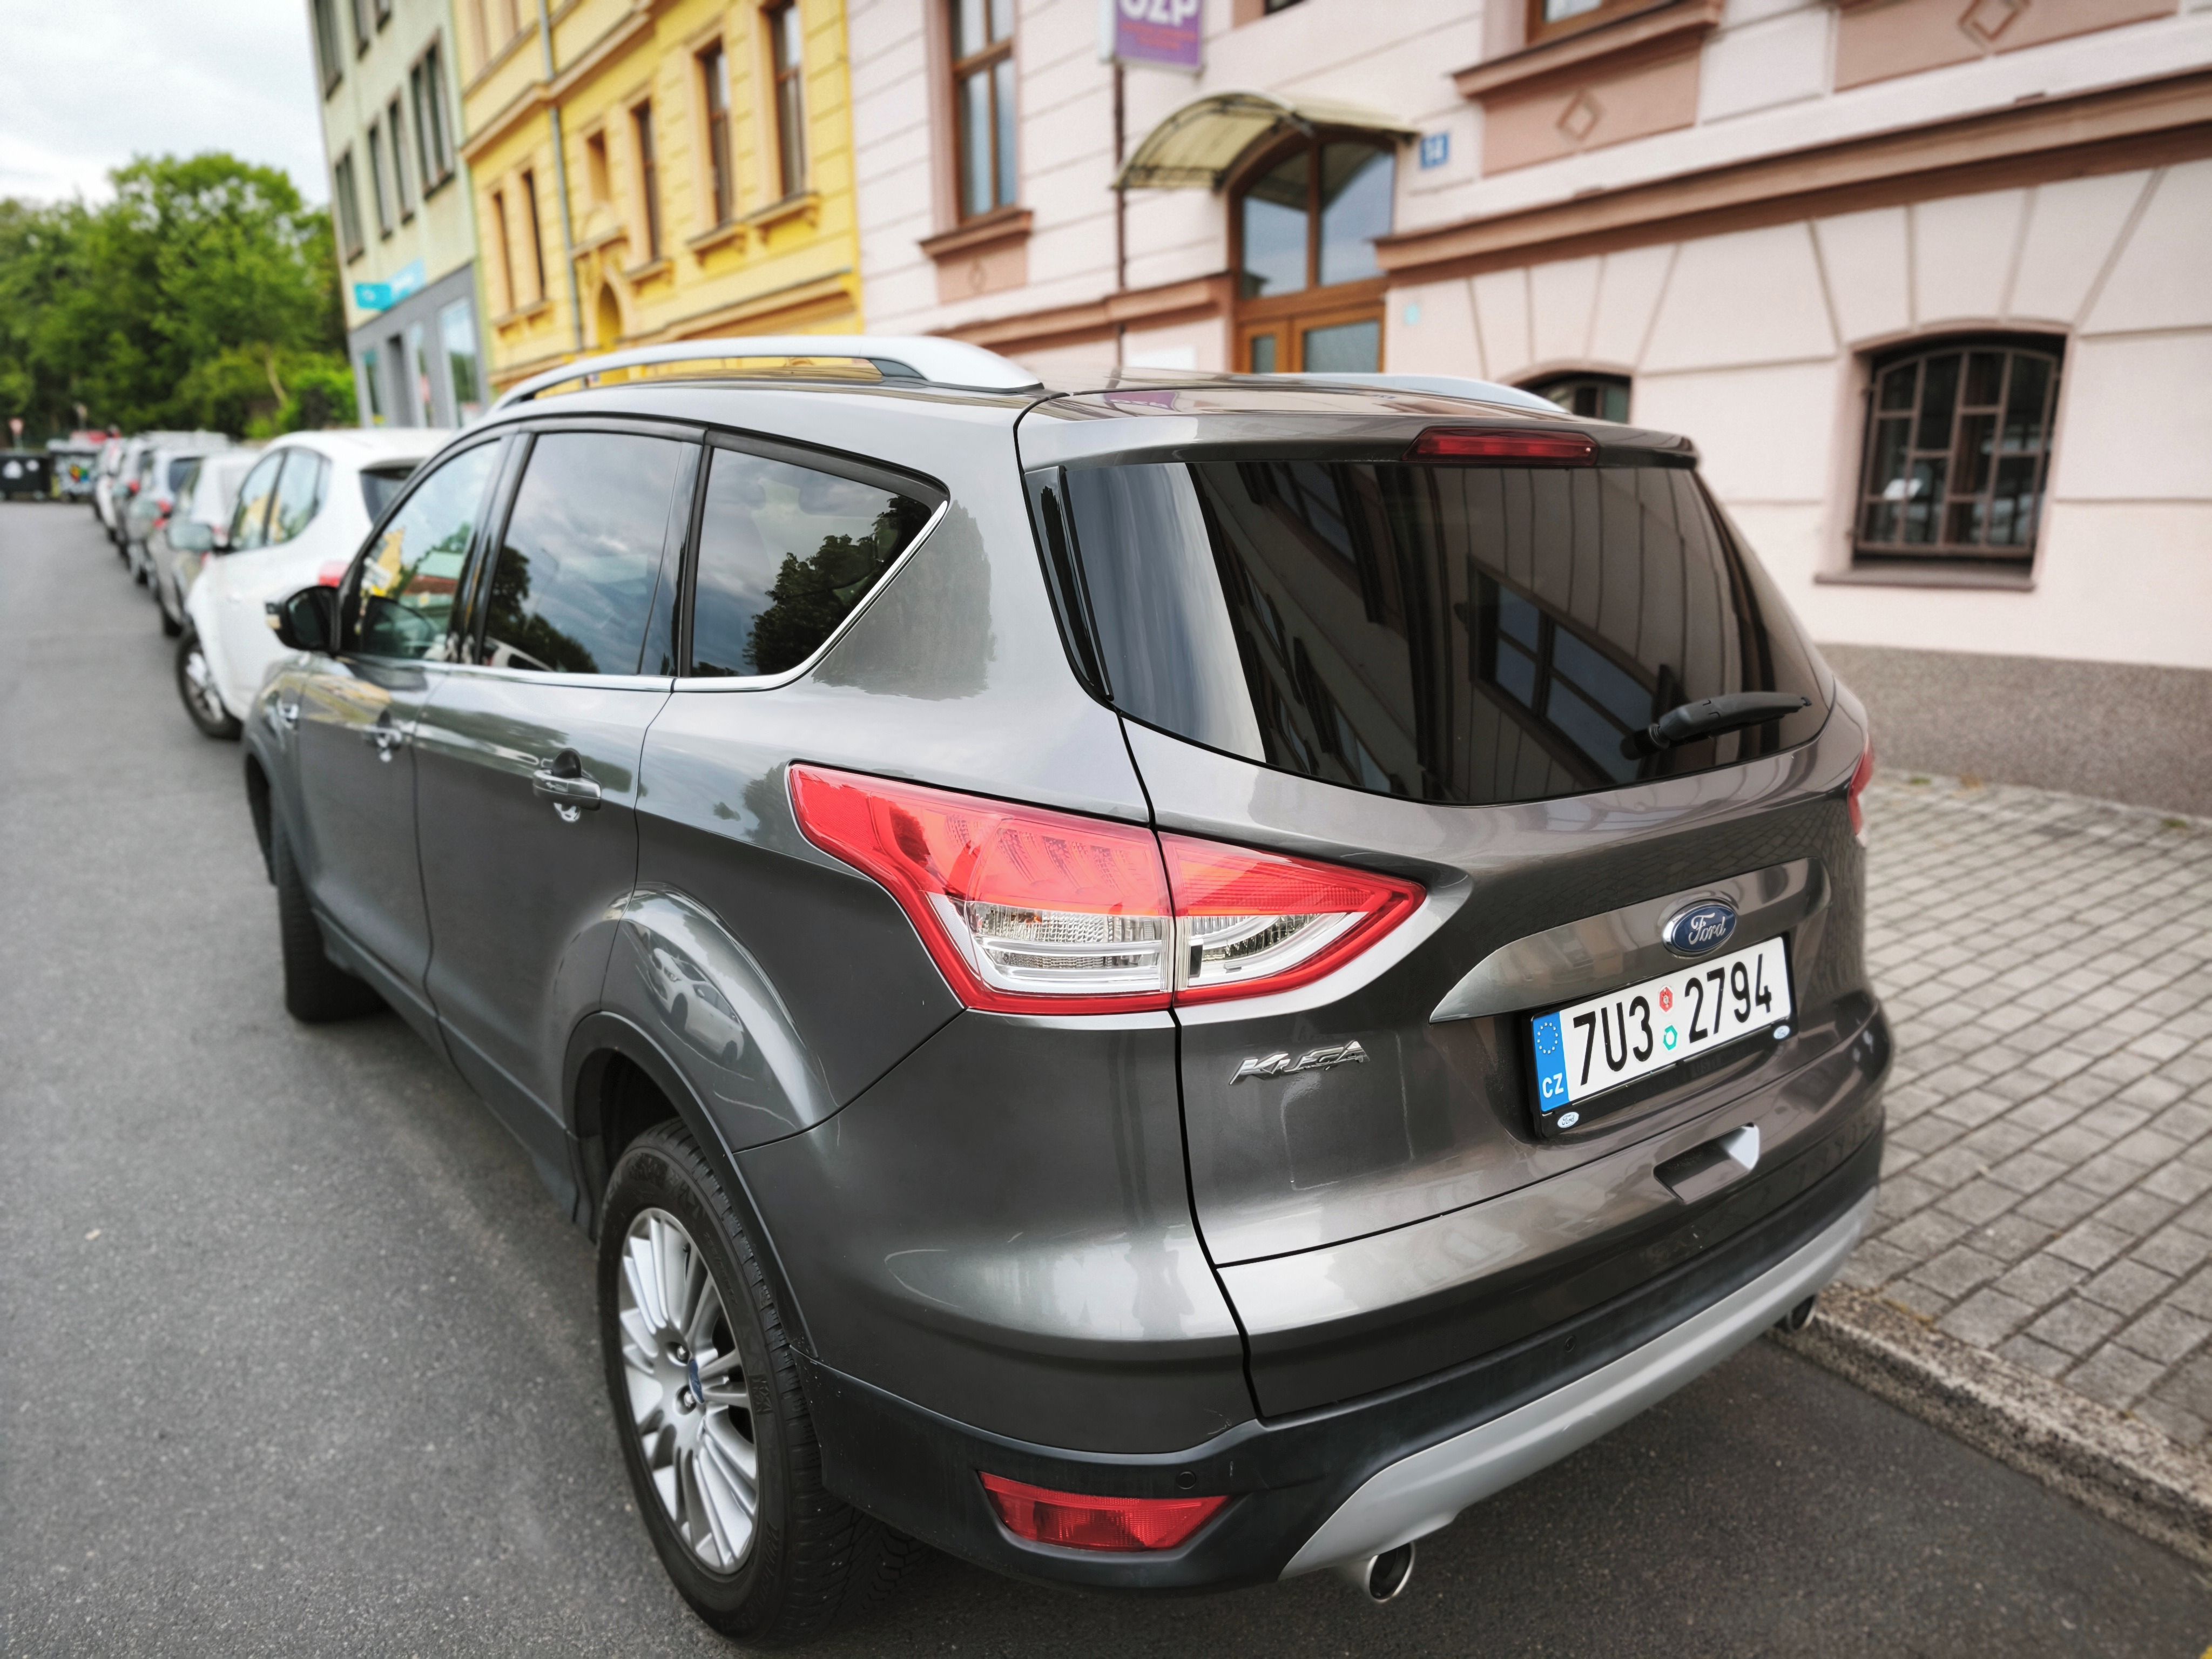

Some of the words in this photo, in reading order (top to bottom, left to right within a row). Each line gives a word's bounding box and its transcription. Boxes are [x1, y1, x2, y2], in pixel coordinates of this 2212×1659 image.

[1688, 913, 1727, 945] Ford
[1573, 996, 1654, 1086] 7U3
[1684, 954, 1772, 1043] 2794
[1542, 1073, 1564, 1098] CZ
